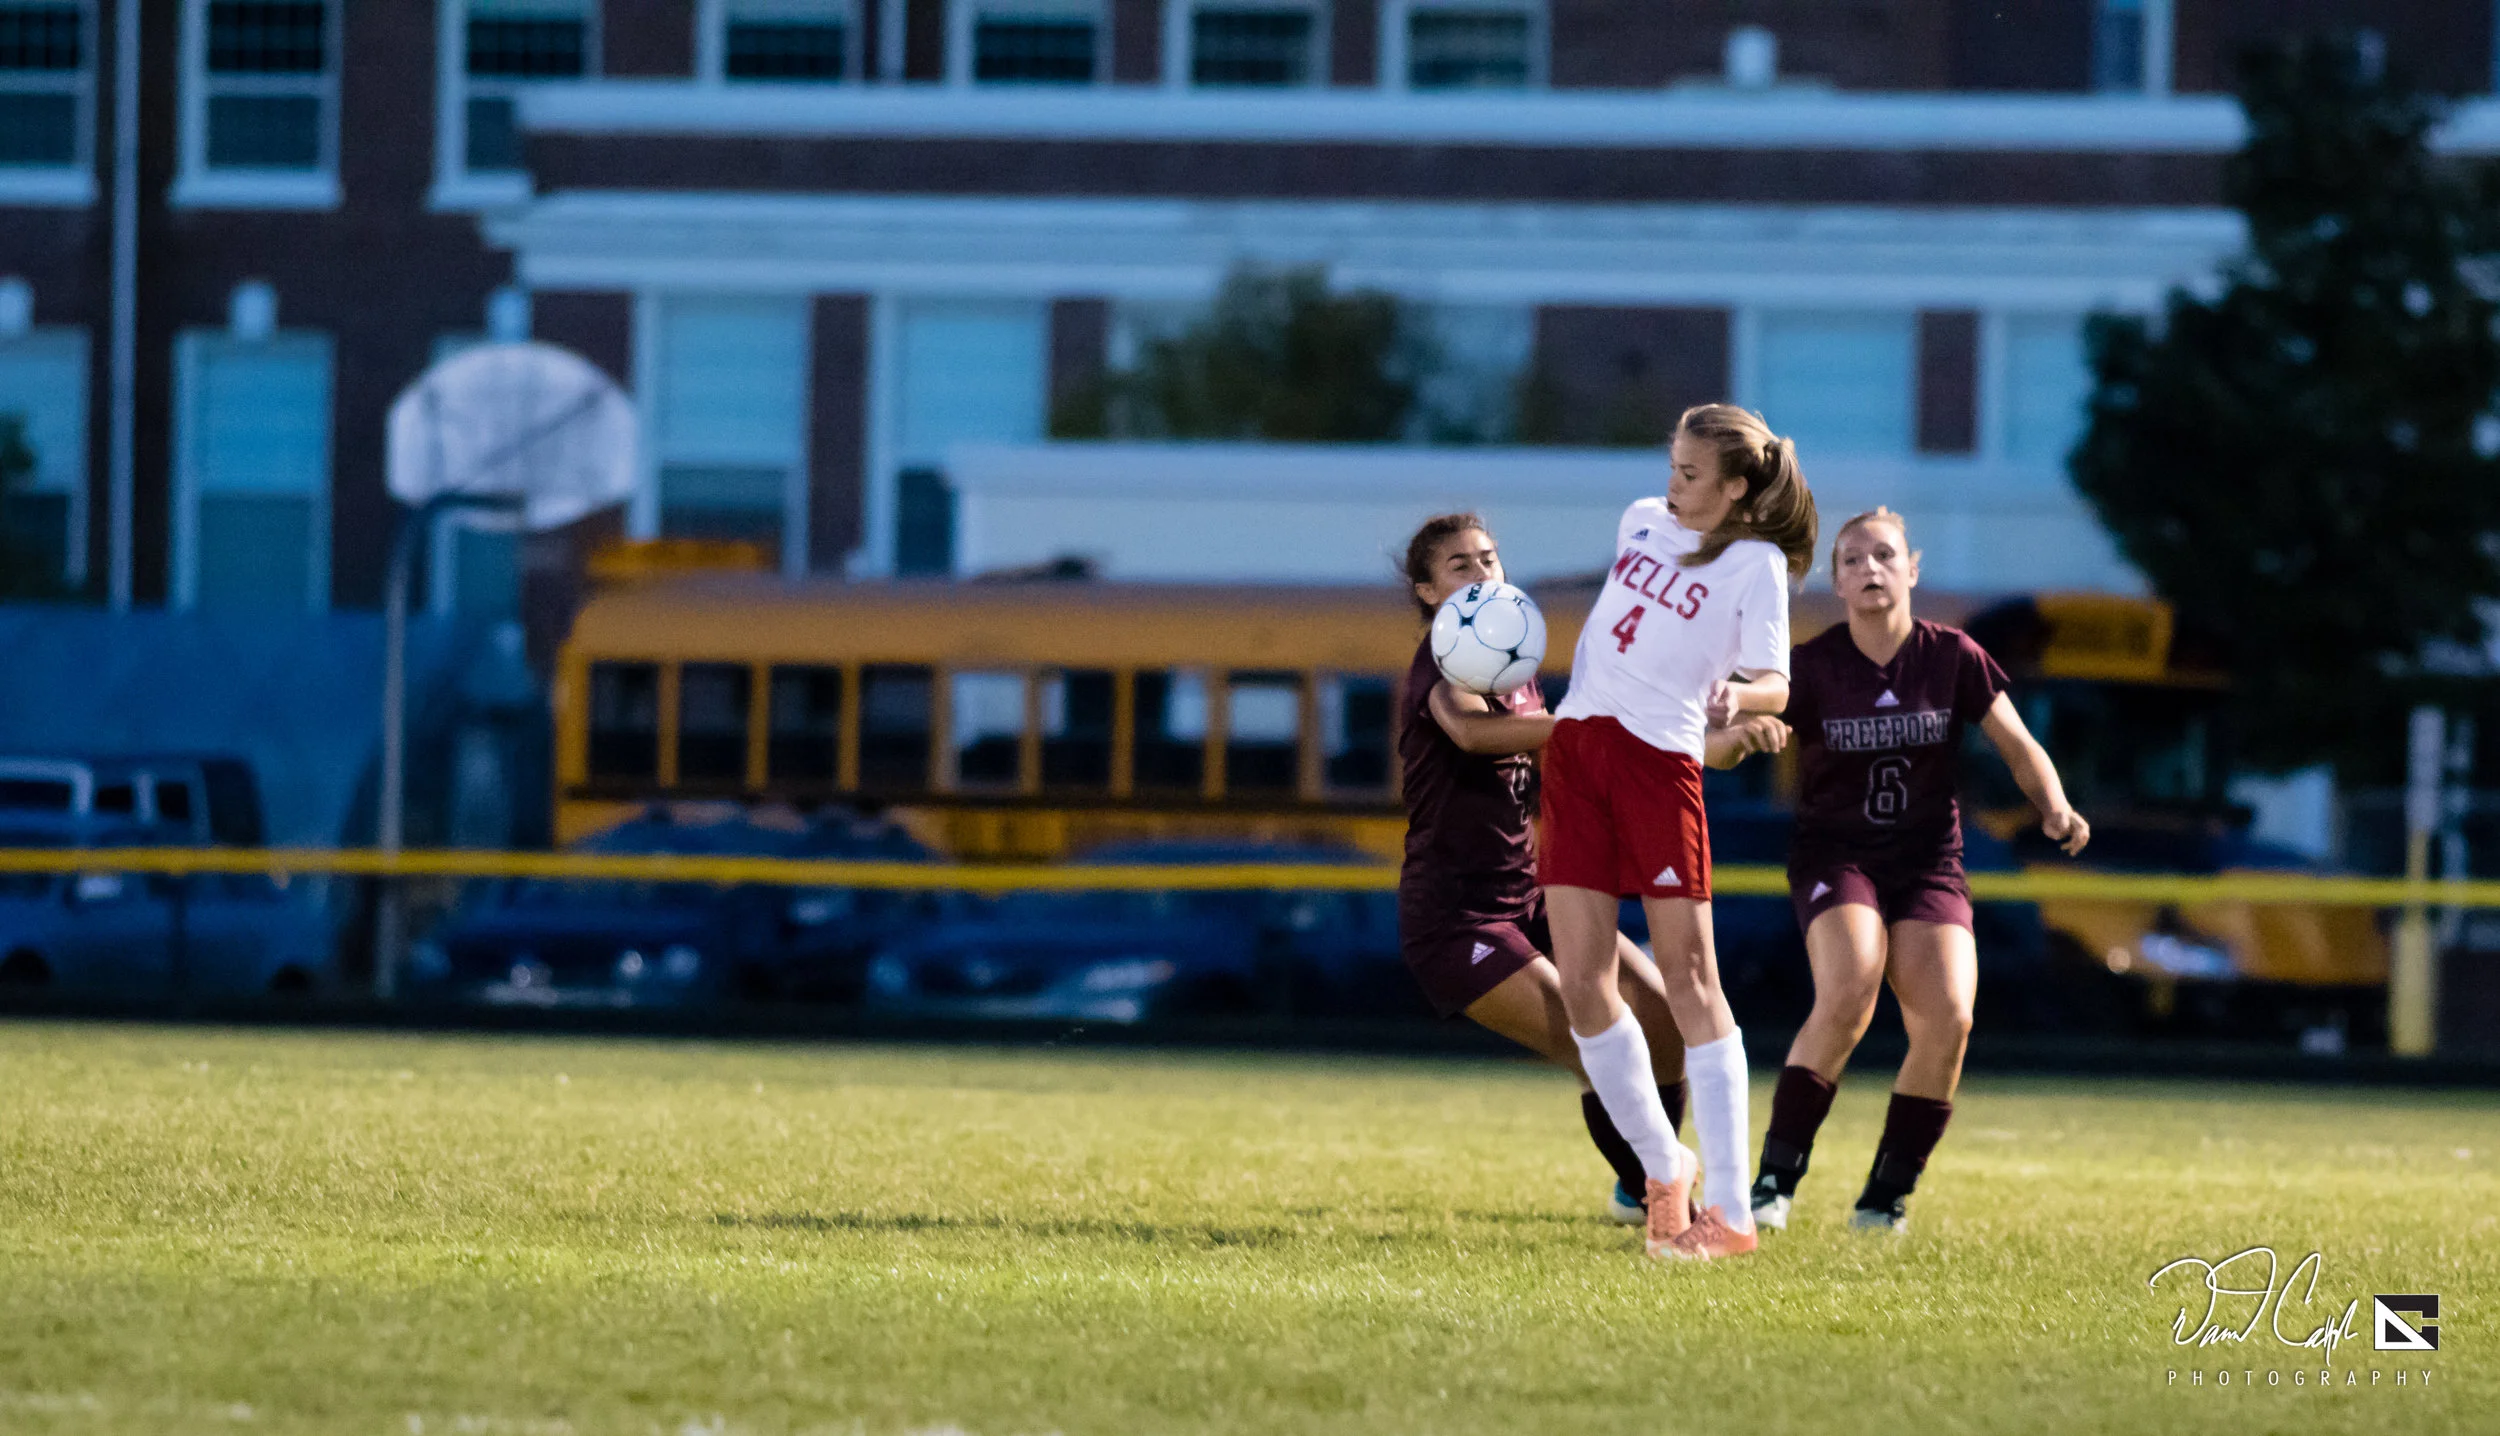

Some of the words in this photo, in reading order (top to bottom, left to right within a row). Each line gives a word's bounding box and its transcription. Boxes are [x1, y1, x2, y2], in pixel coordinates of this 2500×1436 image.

[1614, 549, 1709, 621] WELLS
[1611, 605, 1646, 655] 4
[1822, 708, 1952, 752] FREEPORT
[1864, 756, 1912, 825] 6
